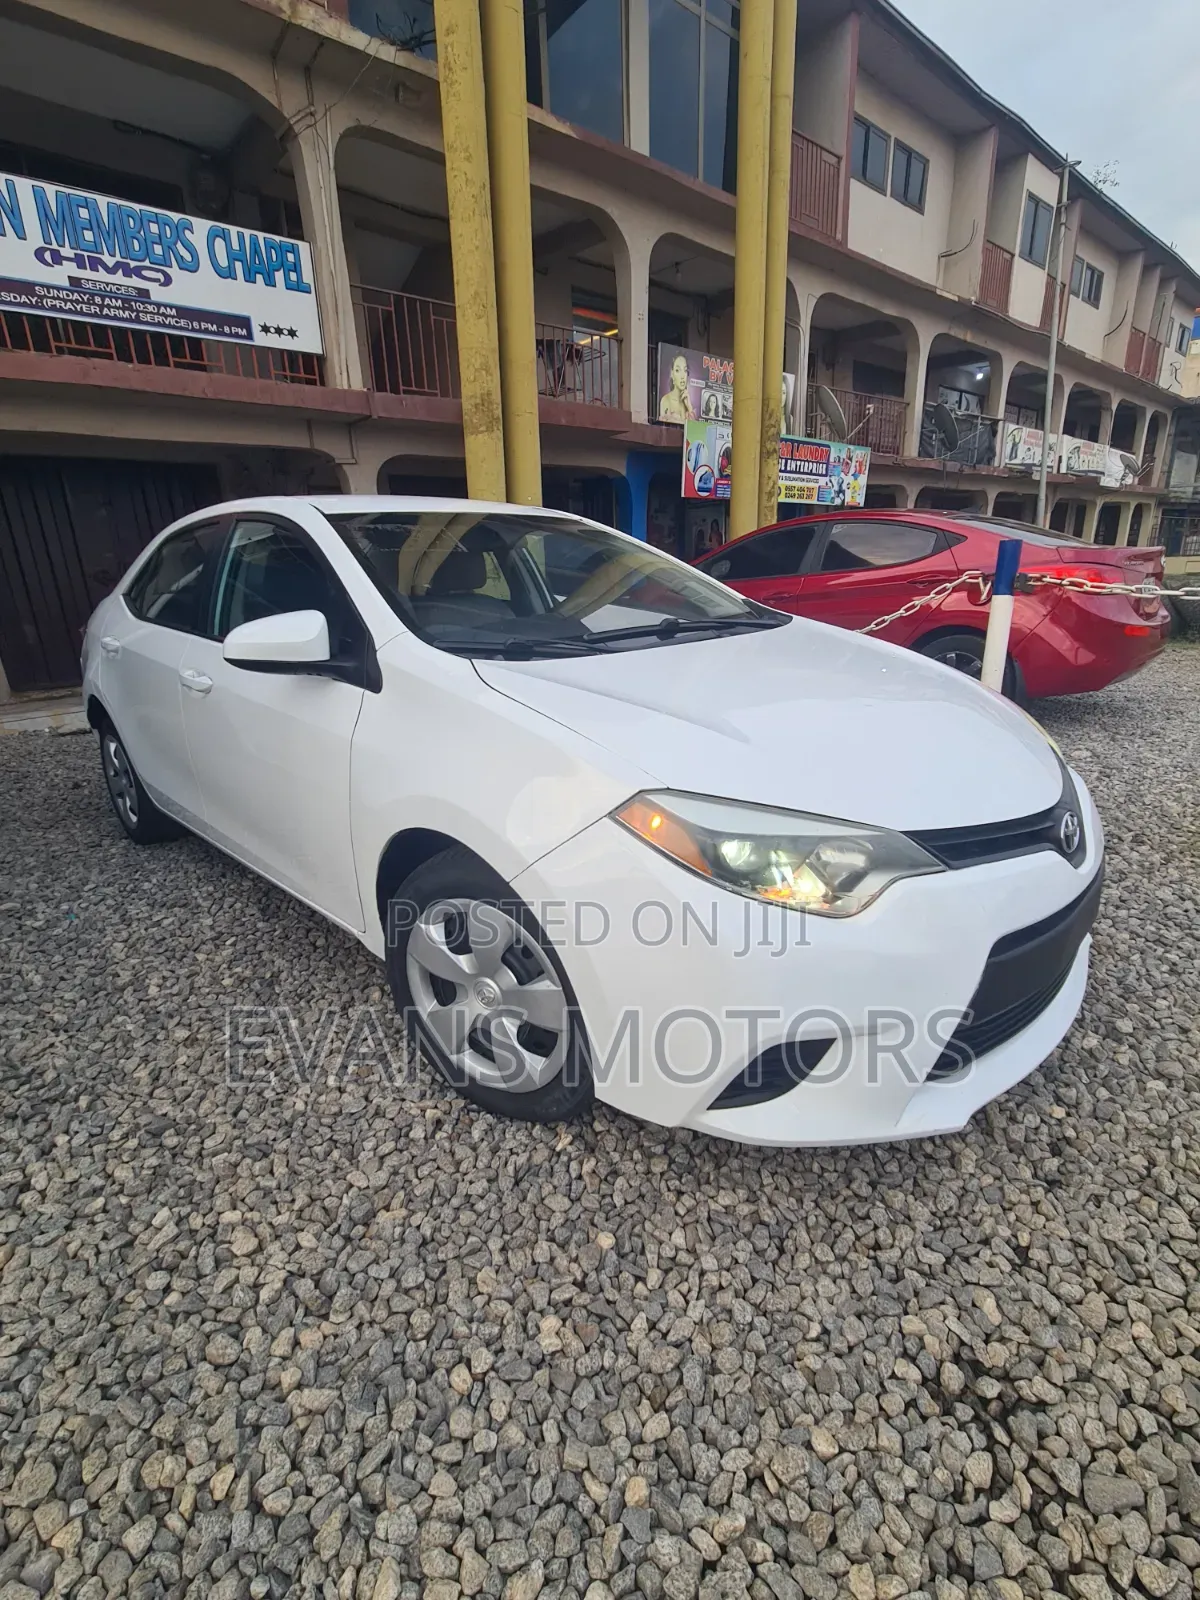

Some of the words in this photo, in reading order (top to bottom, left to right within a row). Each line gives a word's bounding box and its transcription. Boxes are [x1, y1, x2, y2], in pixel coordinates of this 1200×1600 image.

[32, 184, 200, 273] MEMBERS
[206, 225, 312, 294] CHAPEL
[80, 279, 138, 297] SERVICES:
[35, 286, 93, 304] SUNDAY:
[94, 296, 102, 305] 8
[104, 298, 122, 308] AM
[131, 302, 158, 313] 10:30
[160, 307, 177, 316] AM
[0, 291, 42, 306] SDAY:
[43, 298, 101, 315] (PRAYER
[103, 307, 136, 320] ARMY
[139, 313, 192, 329] SERVICE)
[193, 322, 200, 330] 6
[201, 322, 218, 332] PM
[224, 325, 230, 334] 8
[231, 328, 248, 336] PM
[709, 370, 724, 384] BY
[793, 443, 830, 463] LAUNDRY
[787, 459, 827, 475] ENTERPRISE
